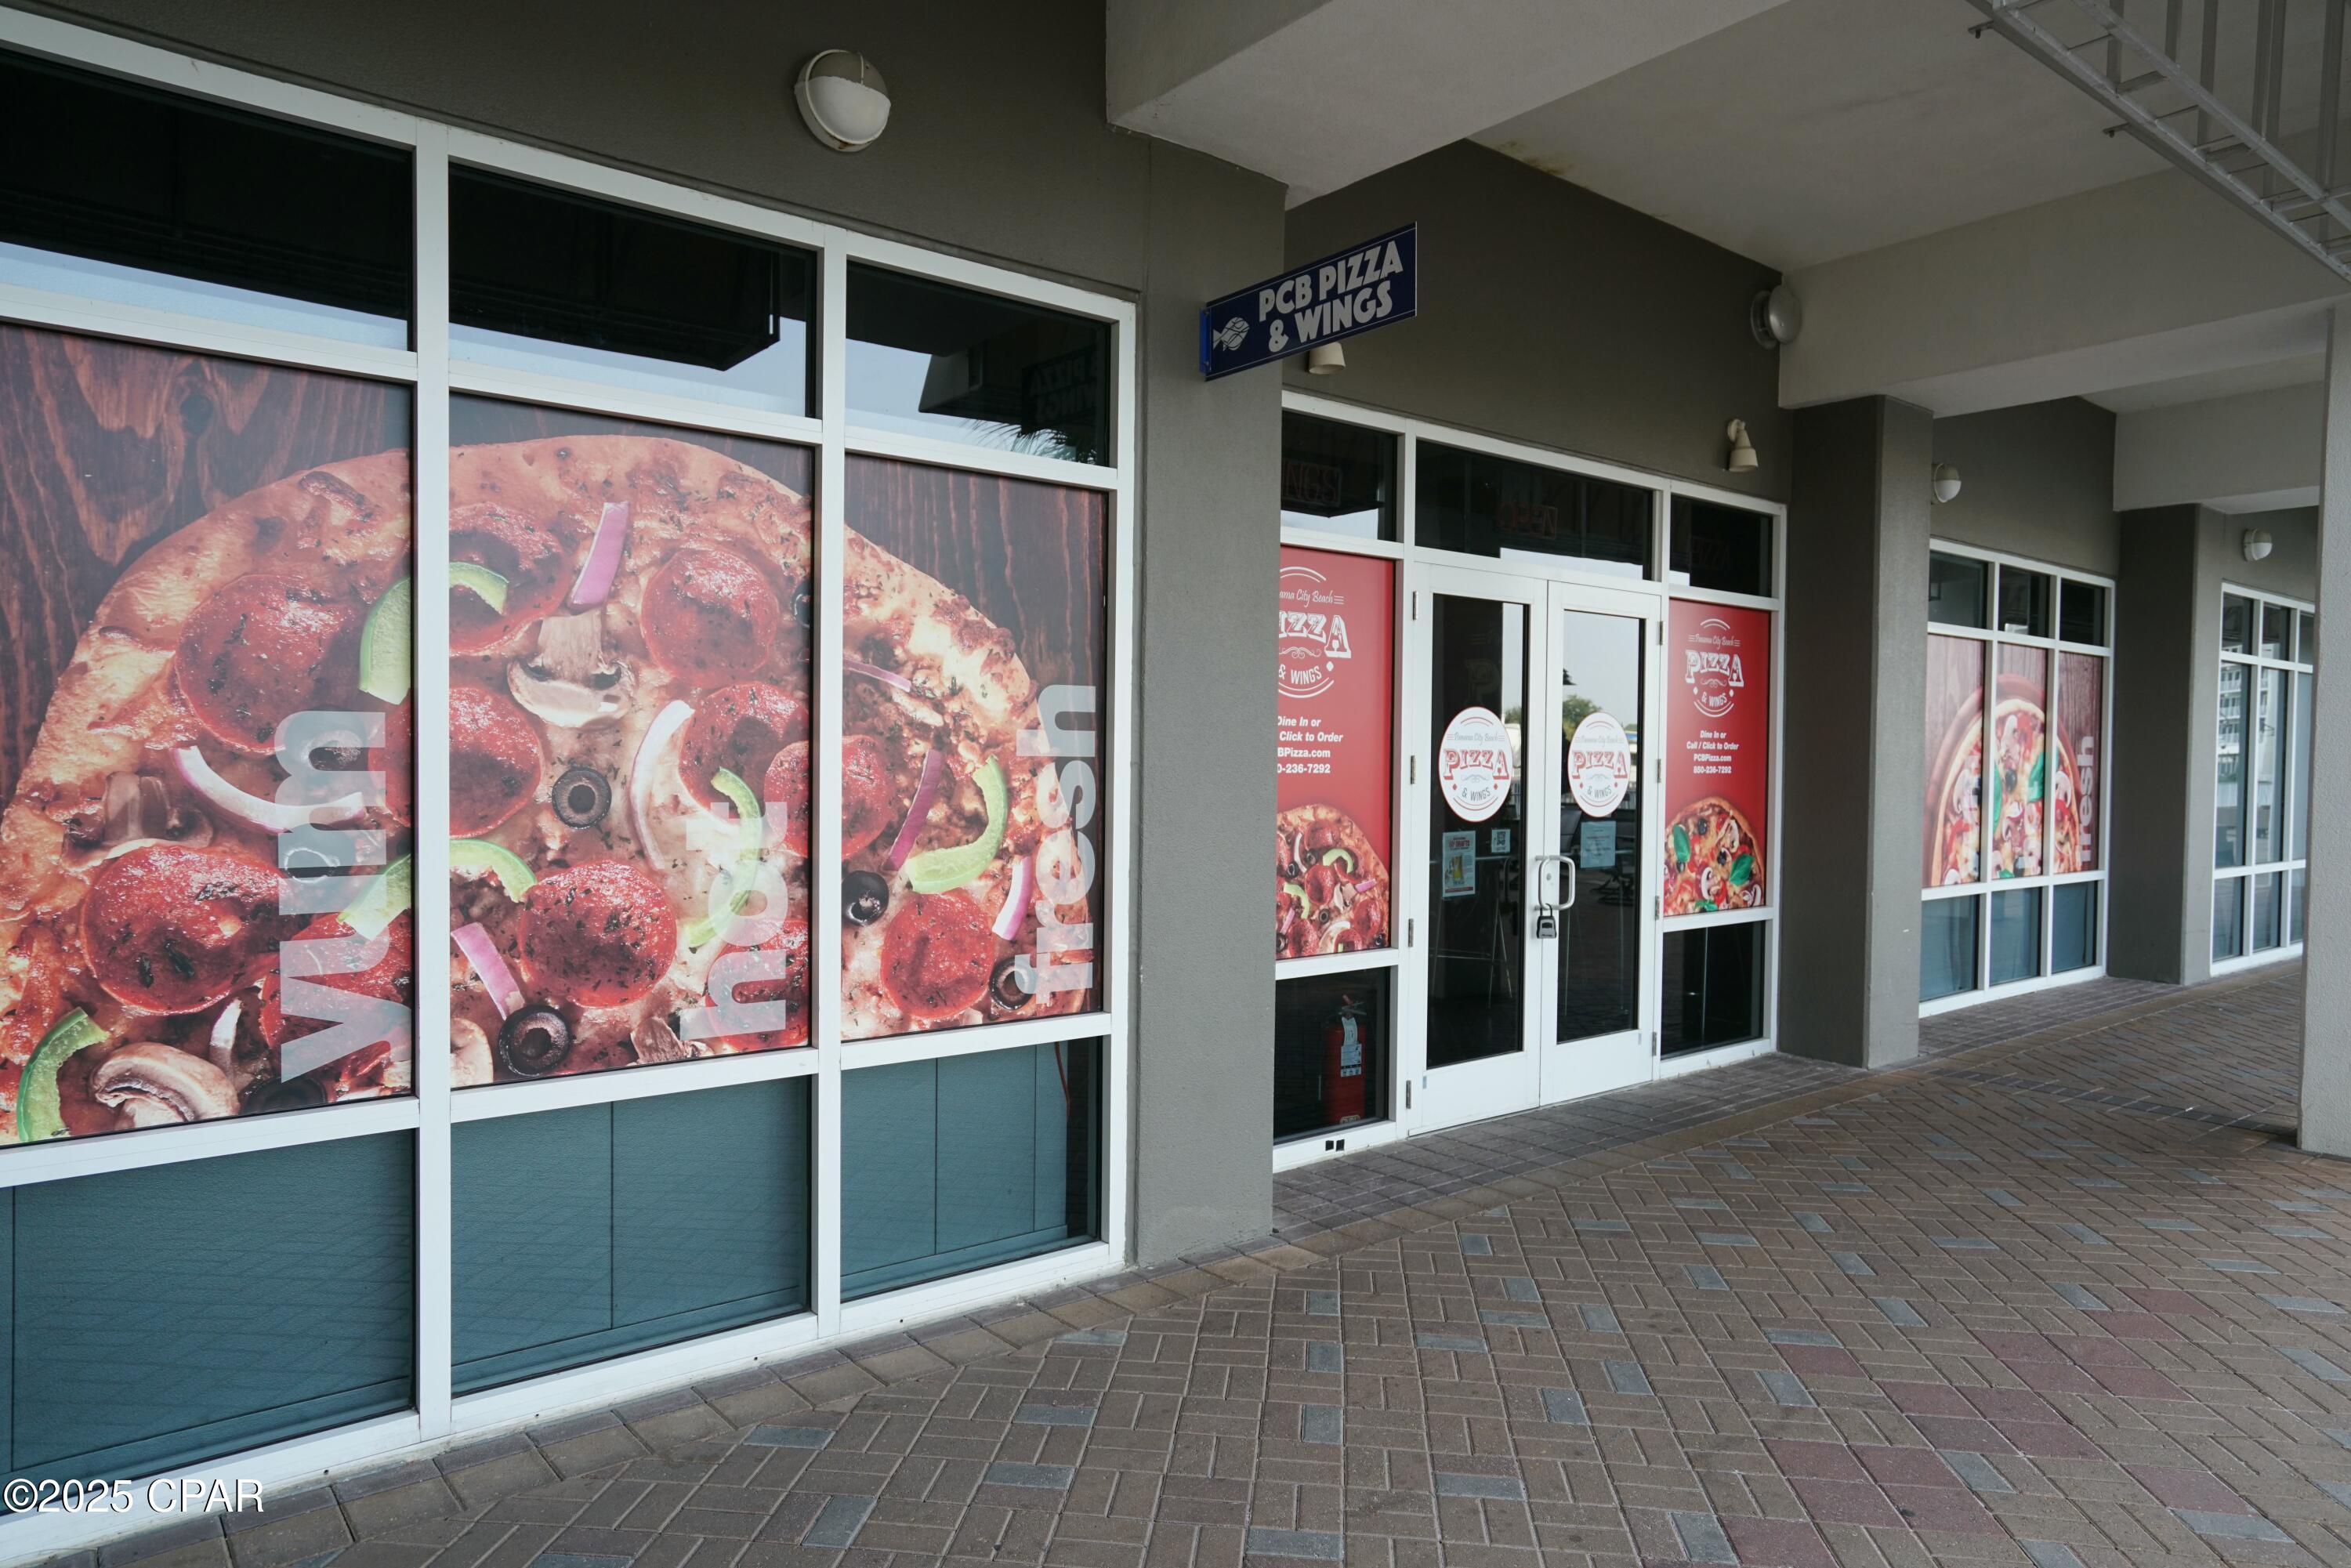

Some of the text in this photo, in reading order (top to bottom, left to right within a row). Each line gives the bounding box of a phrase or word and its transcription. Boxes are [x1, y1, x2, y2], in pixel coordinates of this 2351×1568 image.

[1259, 240, 1404, 322] PCB PIZZA
[1268, 281, 1393, 353] & WINGS
[1296, 589, 1311, 607] City
[1312, 590, 1334, 603] Beach
[1291, 665, 1322, 685] WINGS
[1685, 650, 1744, 687] PIZZA
[1701, 691, 1727, 707] & WINGS
[1299, 716, 1309, 726] In
[1279, 731, 1343, 742] Click to Order
[1686, 741, 1698, 750] Call
[1702, 741, 1716, 750] Click
[1443, 748, 1509, 780] PIZZA
[1572, 751, 1628, 779] PIZZA
[1462, 787, 1491, 801] & WINGS
[1587, 785, 1612, 798] & WINGS
[1014, 684, 1096, 1004] fresh
[679, 802, 788, 1040] hot
